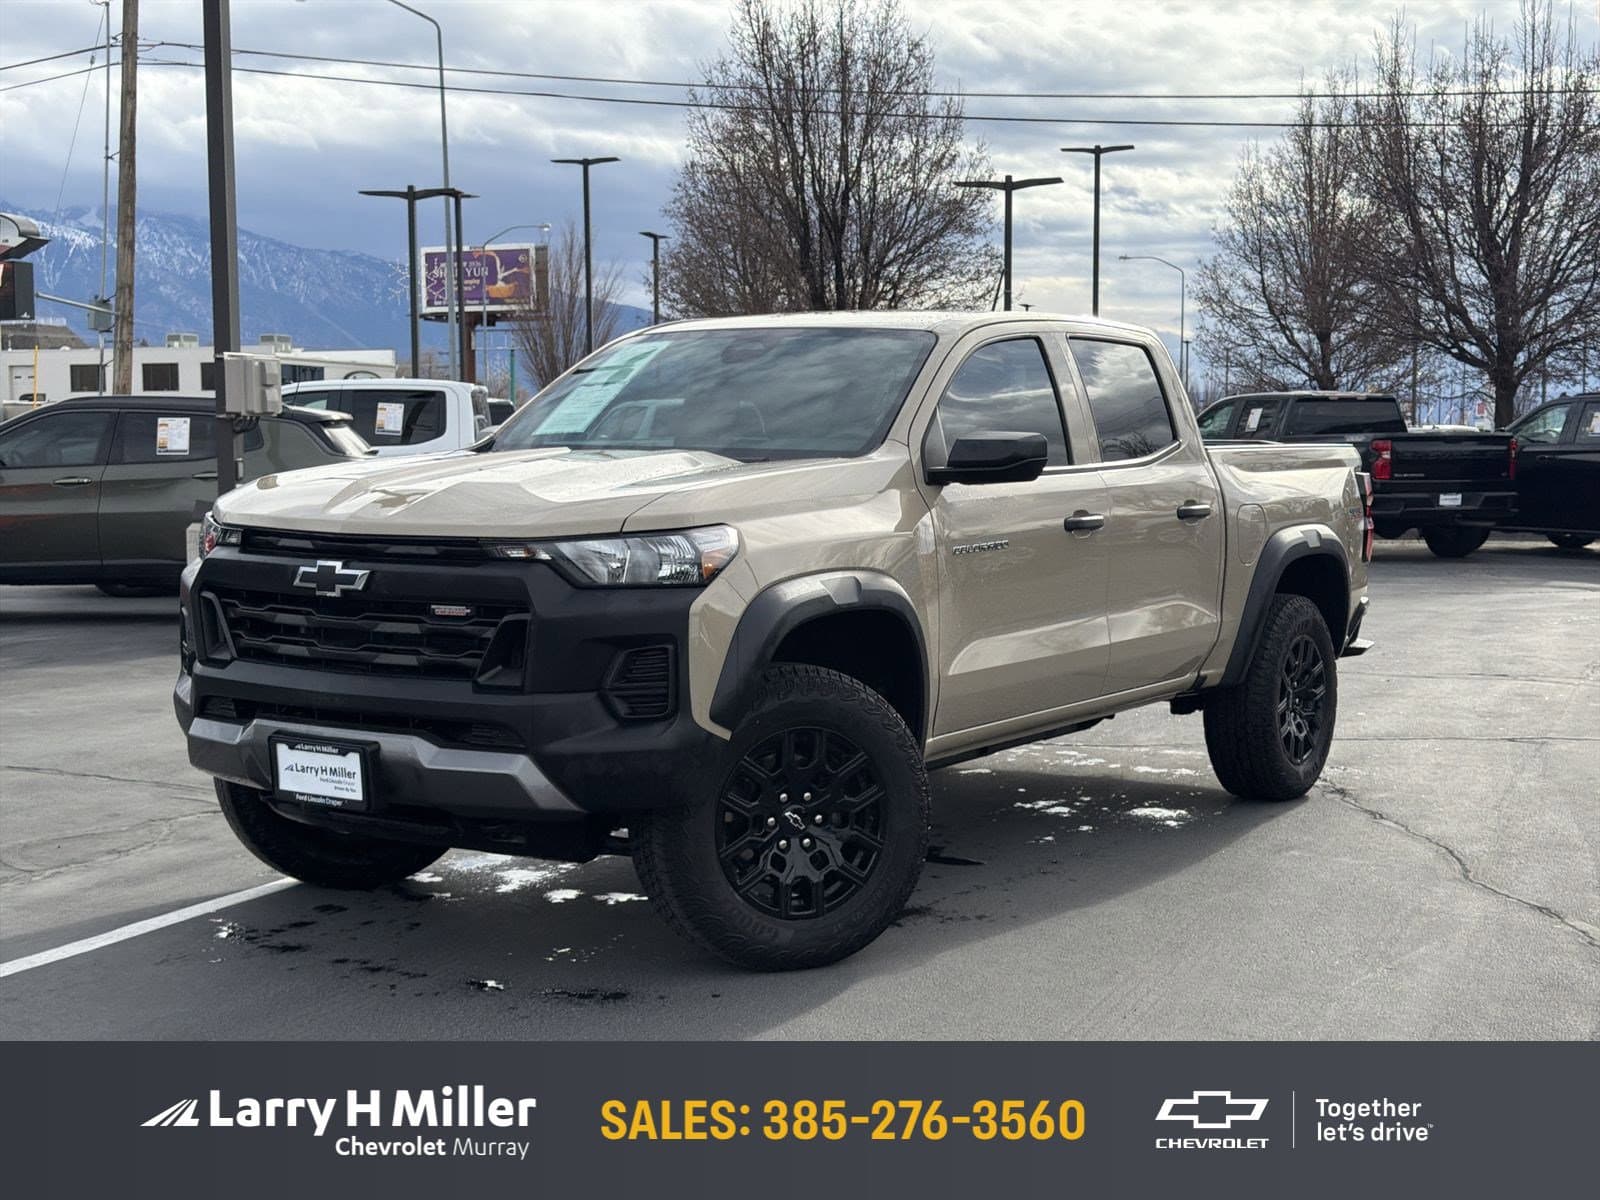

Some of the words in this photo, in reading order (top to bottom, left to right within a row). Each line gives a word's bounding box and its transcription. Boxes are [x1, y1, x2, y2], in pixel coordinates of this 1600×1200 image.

[294, 763, 319, 777] Larry
[320, 766, 328, 776] H
[329, 766, 356, 778] Miller
